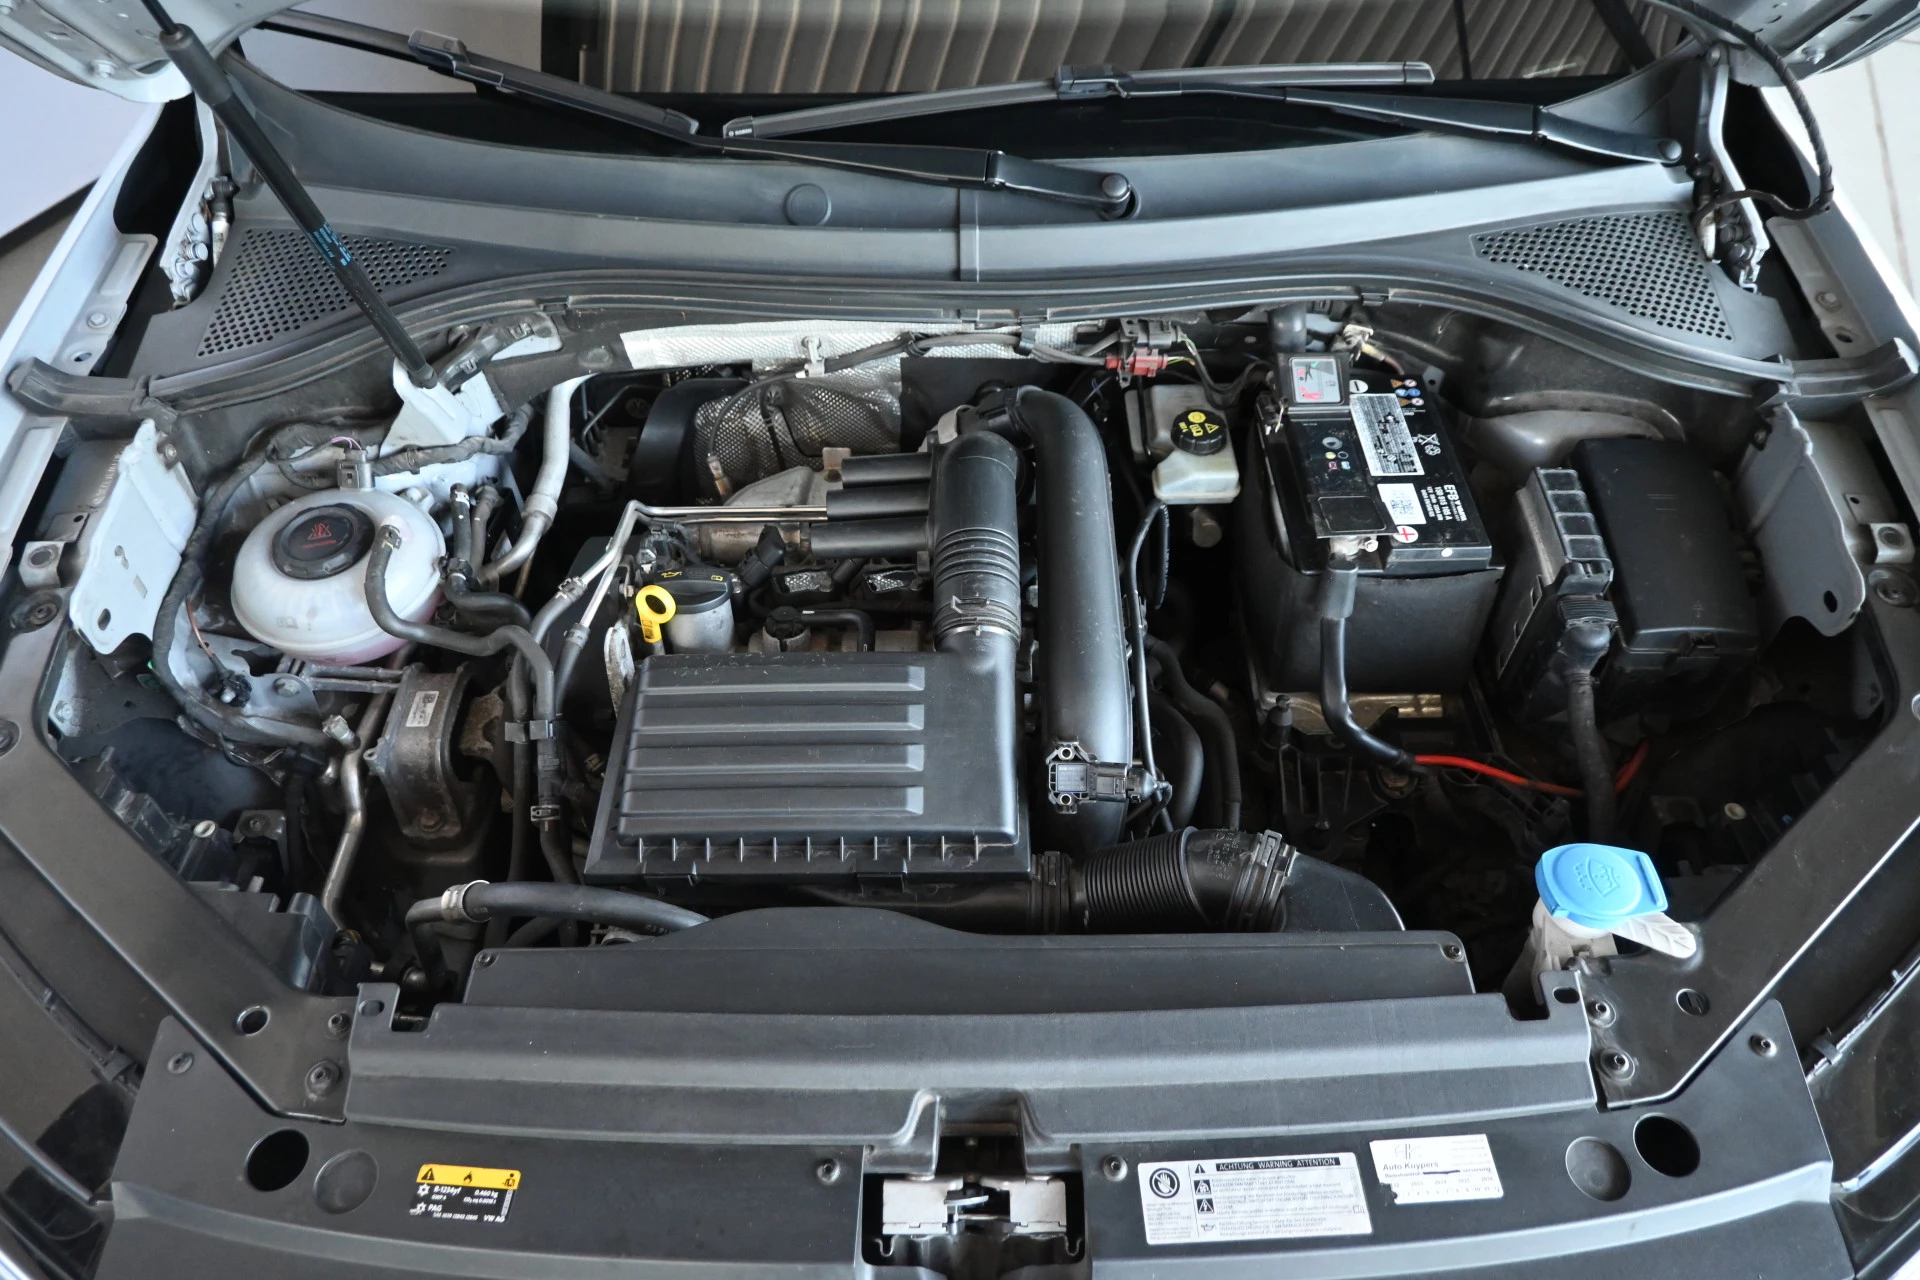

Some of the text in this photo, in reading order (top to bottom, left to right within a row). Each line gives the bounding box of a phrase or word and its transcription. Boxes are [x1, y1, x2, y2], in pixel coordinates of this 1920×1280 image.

[1220, 1158, 1336, 1170] ACHTUNG WARNING ATTENTION
[1405, 1162, 1439, 1170] Kuypers
[428, 1204, 442, 1212] PAG
